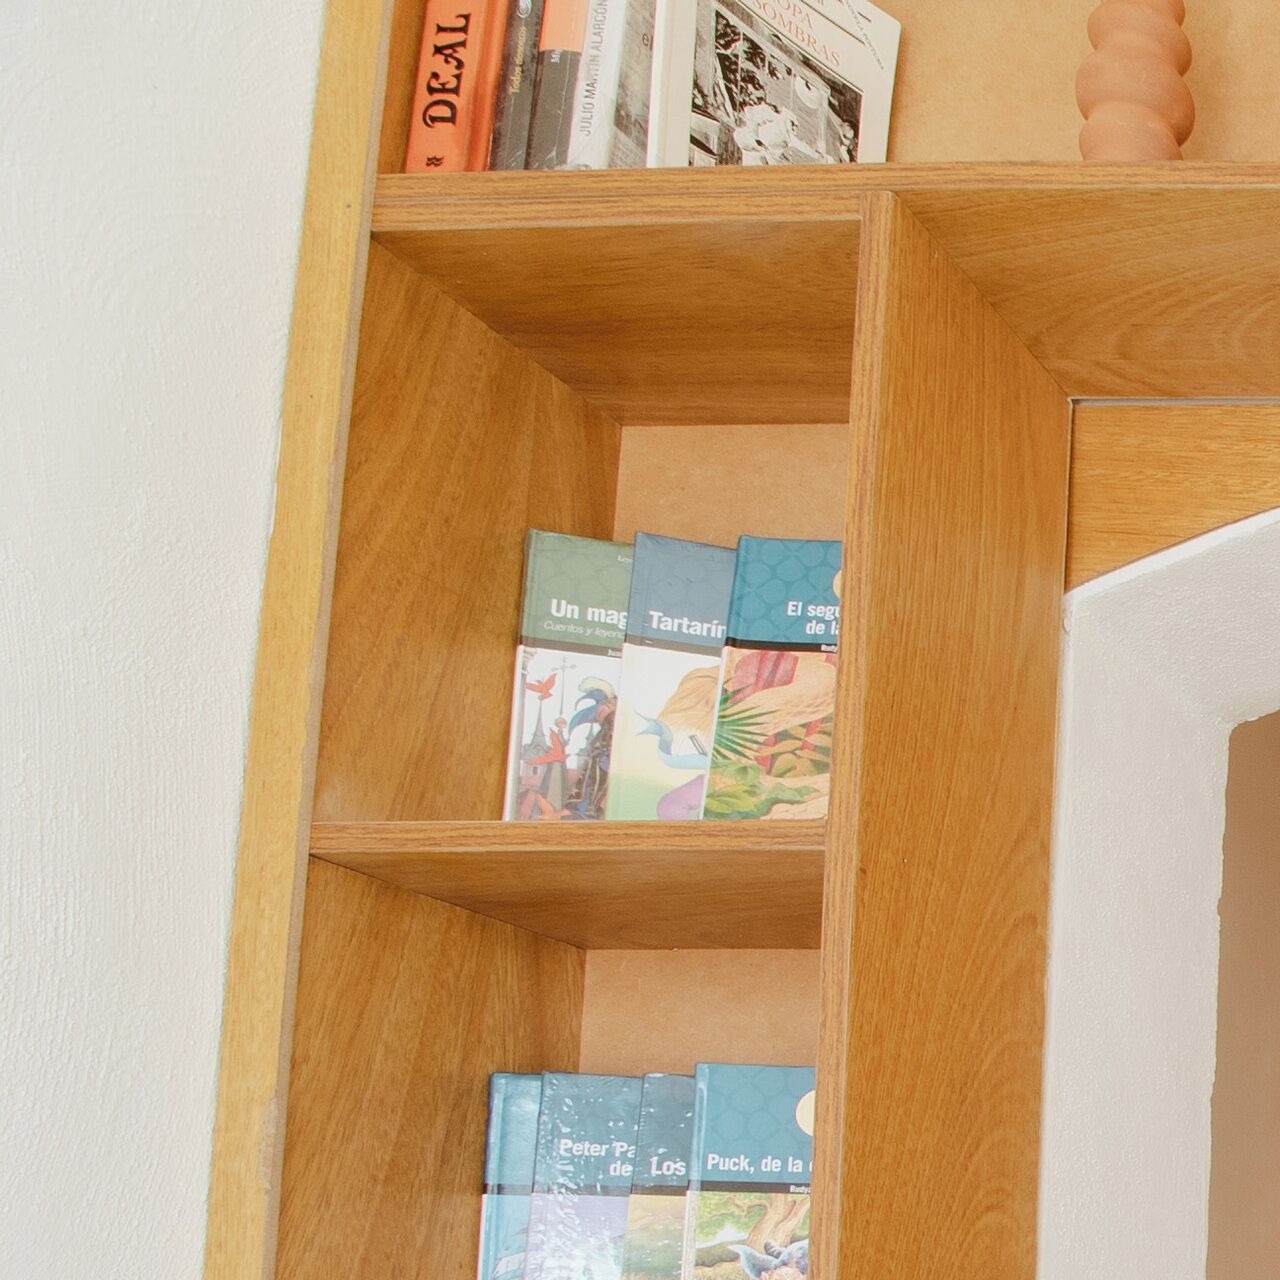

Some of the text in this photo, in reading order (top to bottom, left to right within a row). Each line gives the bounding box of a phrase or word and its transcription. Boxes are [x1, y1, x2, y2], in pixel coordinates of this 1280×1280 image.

[422, 12, 472, 129] DEAL
[586, 53, 601, 99] MARTÍN
[580, 102, 596, 136] JULIO
[549, 598, 580, 620] Un
[786, 601, 802, 617] El
[543, 619, 585, 635] Cuentos
[805, 619, 825, 635] de
[558, 1138, 636, 1158] Peter Pa
[609, 1159, 634, 1176] de
[649, 1155, 687, 1176] Los
[706, 1152, 804, 1174] Puck, de la
